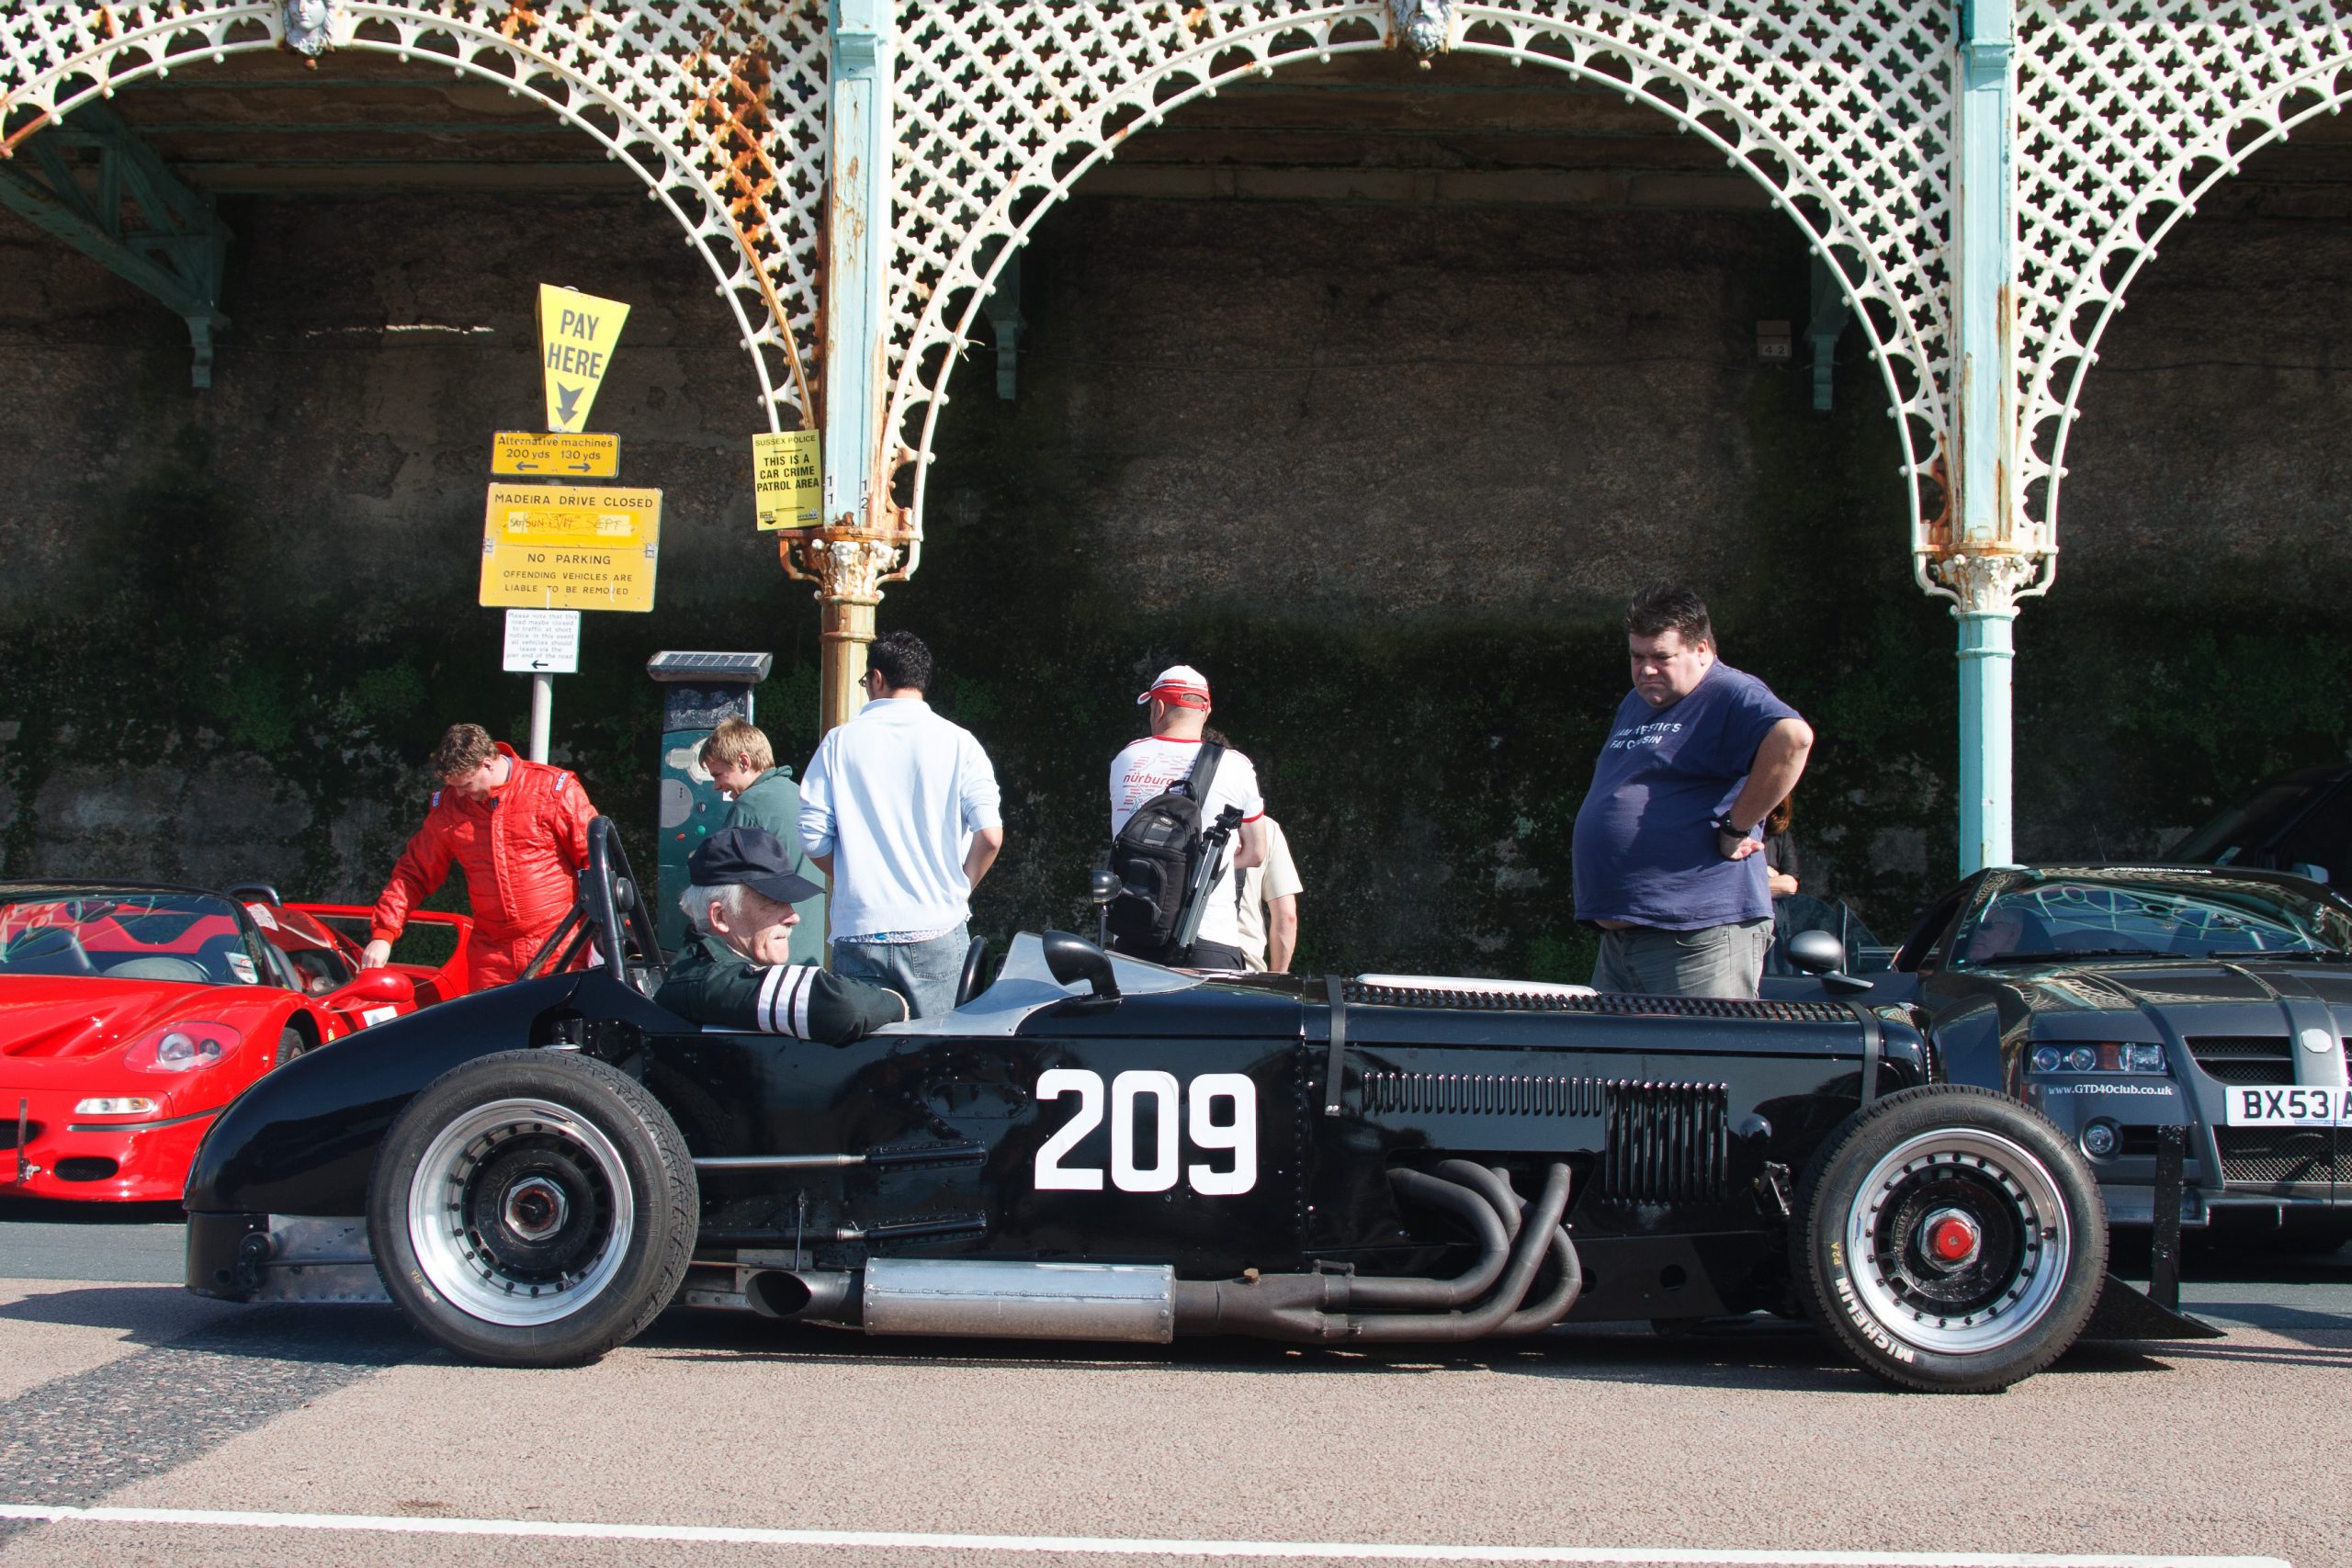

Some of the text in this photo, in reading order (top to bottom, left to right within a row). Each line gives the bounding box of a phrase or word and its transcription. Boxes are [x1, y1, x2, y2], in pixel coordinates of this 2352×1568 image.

[560, 309, 600, 342] PAY
[547, 342, 604, 379] HERE
[498, 435, 613, 447] Alternative machines
[755, 434, 816, 446] SUSSEX POLICE
[506, 448, 601, 462] 200 yds 130 yds
[763, 454, 810, 467] THIS IS A
[760, 466, 815, 479] CAR CRIME
[756, 478, 820, 492] PATROL AREA
[494, 493, 653, 508] MADEIRA DRIVE CLOSED
[527, 553, 611, 565] NO PARKING
[503, 570, 556, 580] OFFENDING
[562, 571, 608, 581] VEHICLES
[504, 584, 537, 592] LIABLE
[547, 585, 559, 593] TO
[582, 586, 628, 595] REMOVED
[1626, 735, 1662, 750] CSIN
[2048, 1084, 2173, 1096] www.GTD40club.co.uk
[2243, 1090, 2329, 1119] BX53
[1035, 1068, 1258, 1196] 209
[1831, 1242, 1842, 1266] P2A
[1836, 1277, 1914, 1364] MICHELIN
